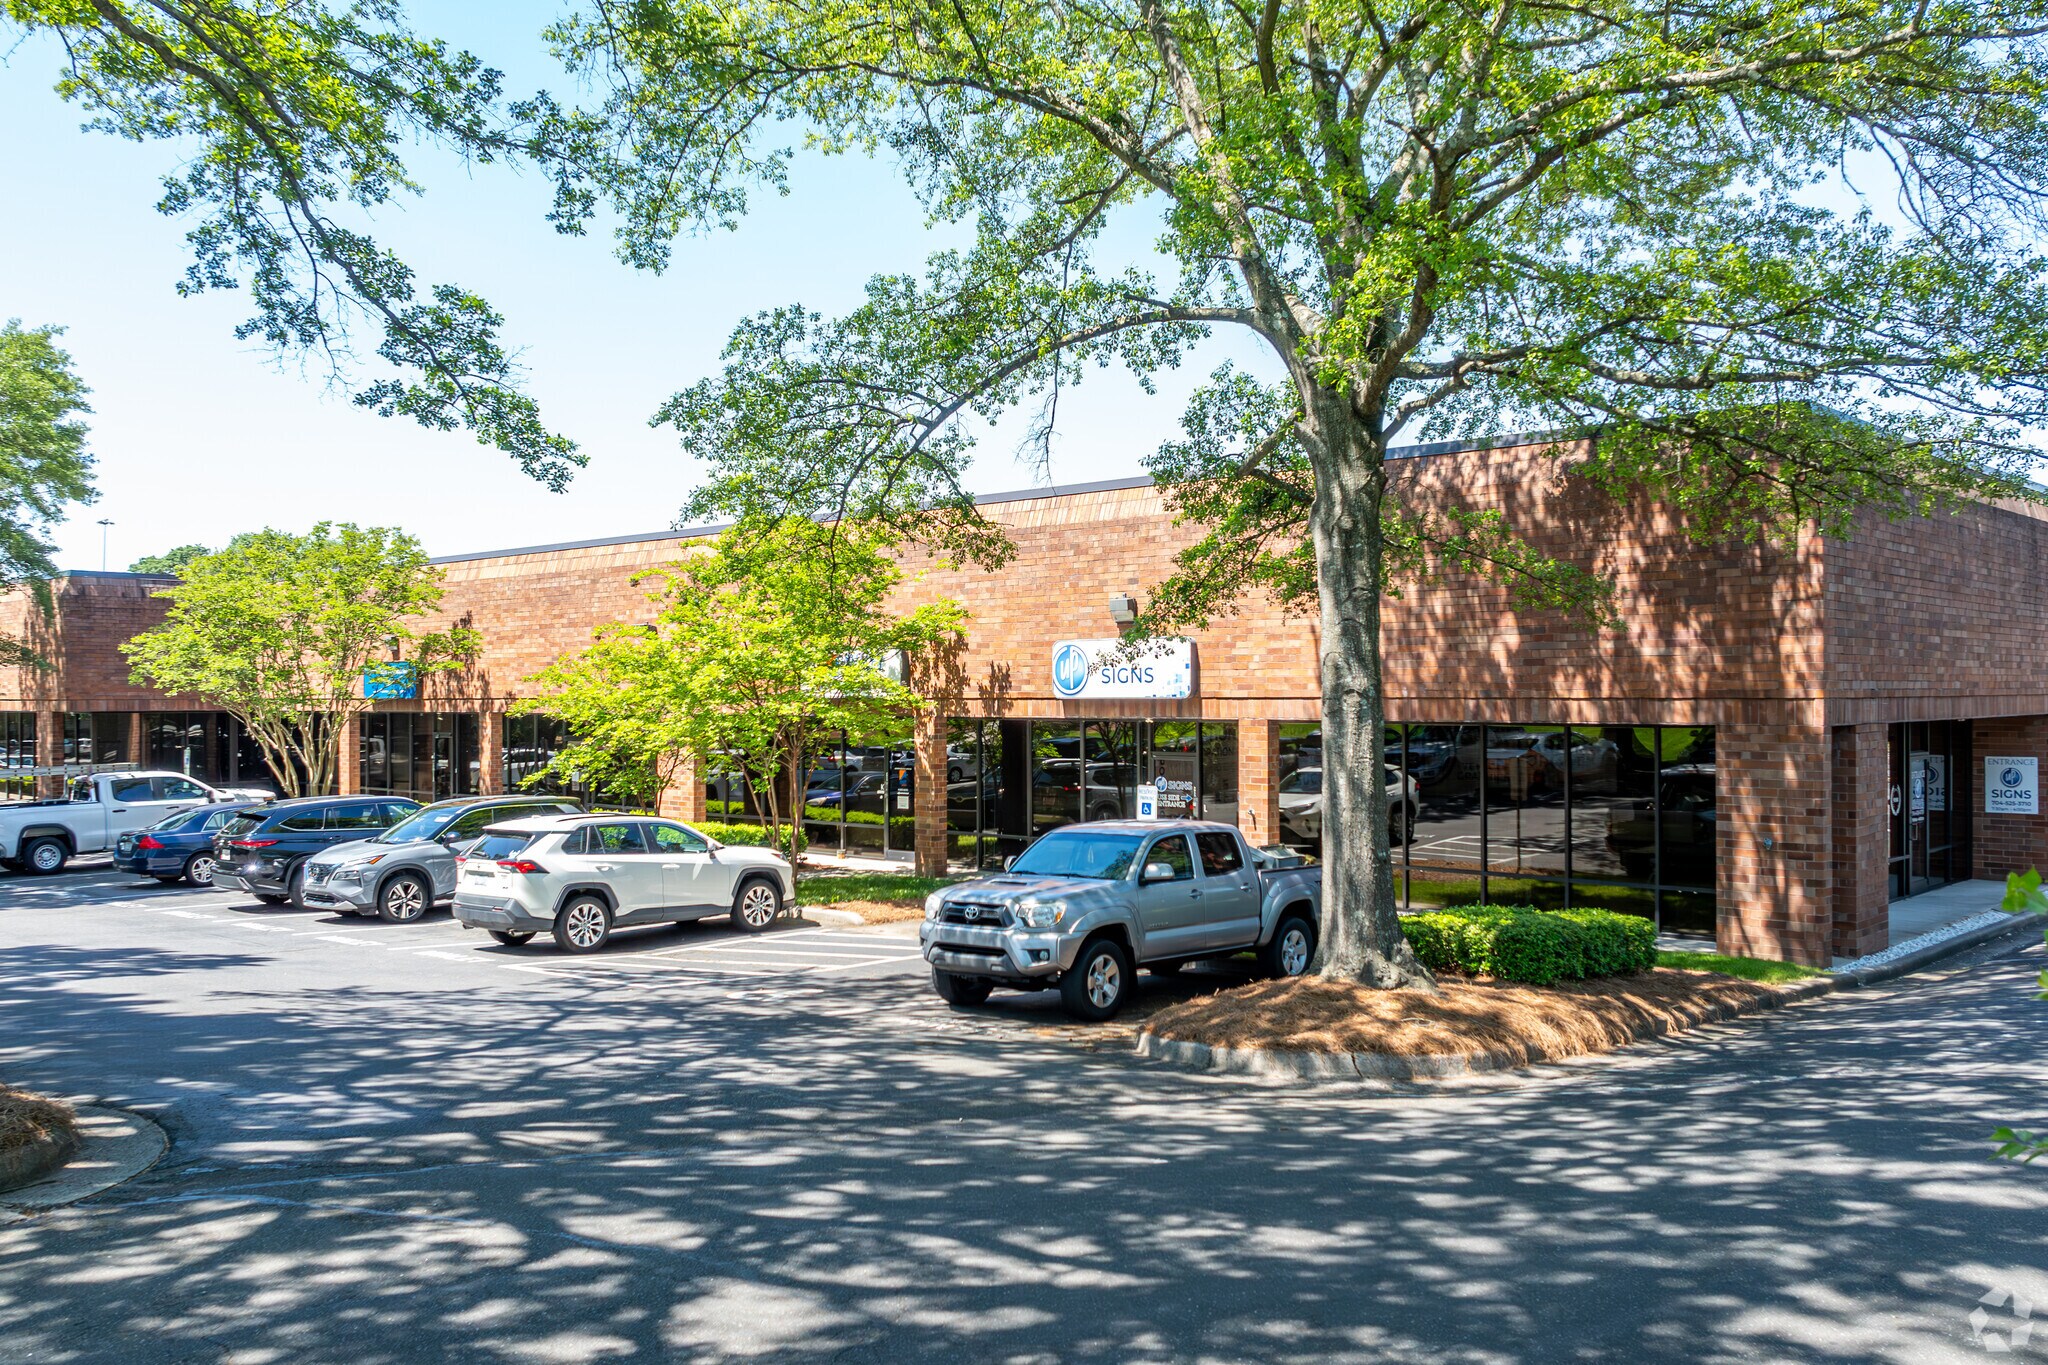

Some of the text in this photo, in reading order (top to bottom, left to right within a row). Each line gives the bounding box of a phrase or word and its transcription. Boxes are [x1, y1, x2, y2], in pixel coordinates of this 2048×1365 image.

[1101, 667, 1154, 684] SIGNS
[1987, 758, 2035, 766] ENTRANCE
[1168, 781, 1192, 790] SIGNS
[1991, 789, 2032, 799] SIGNS
